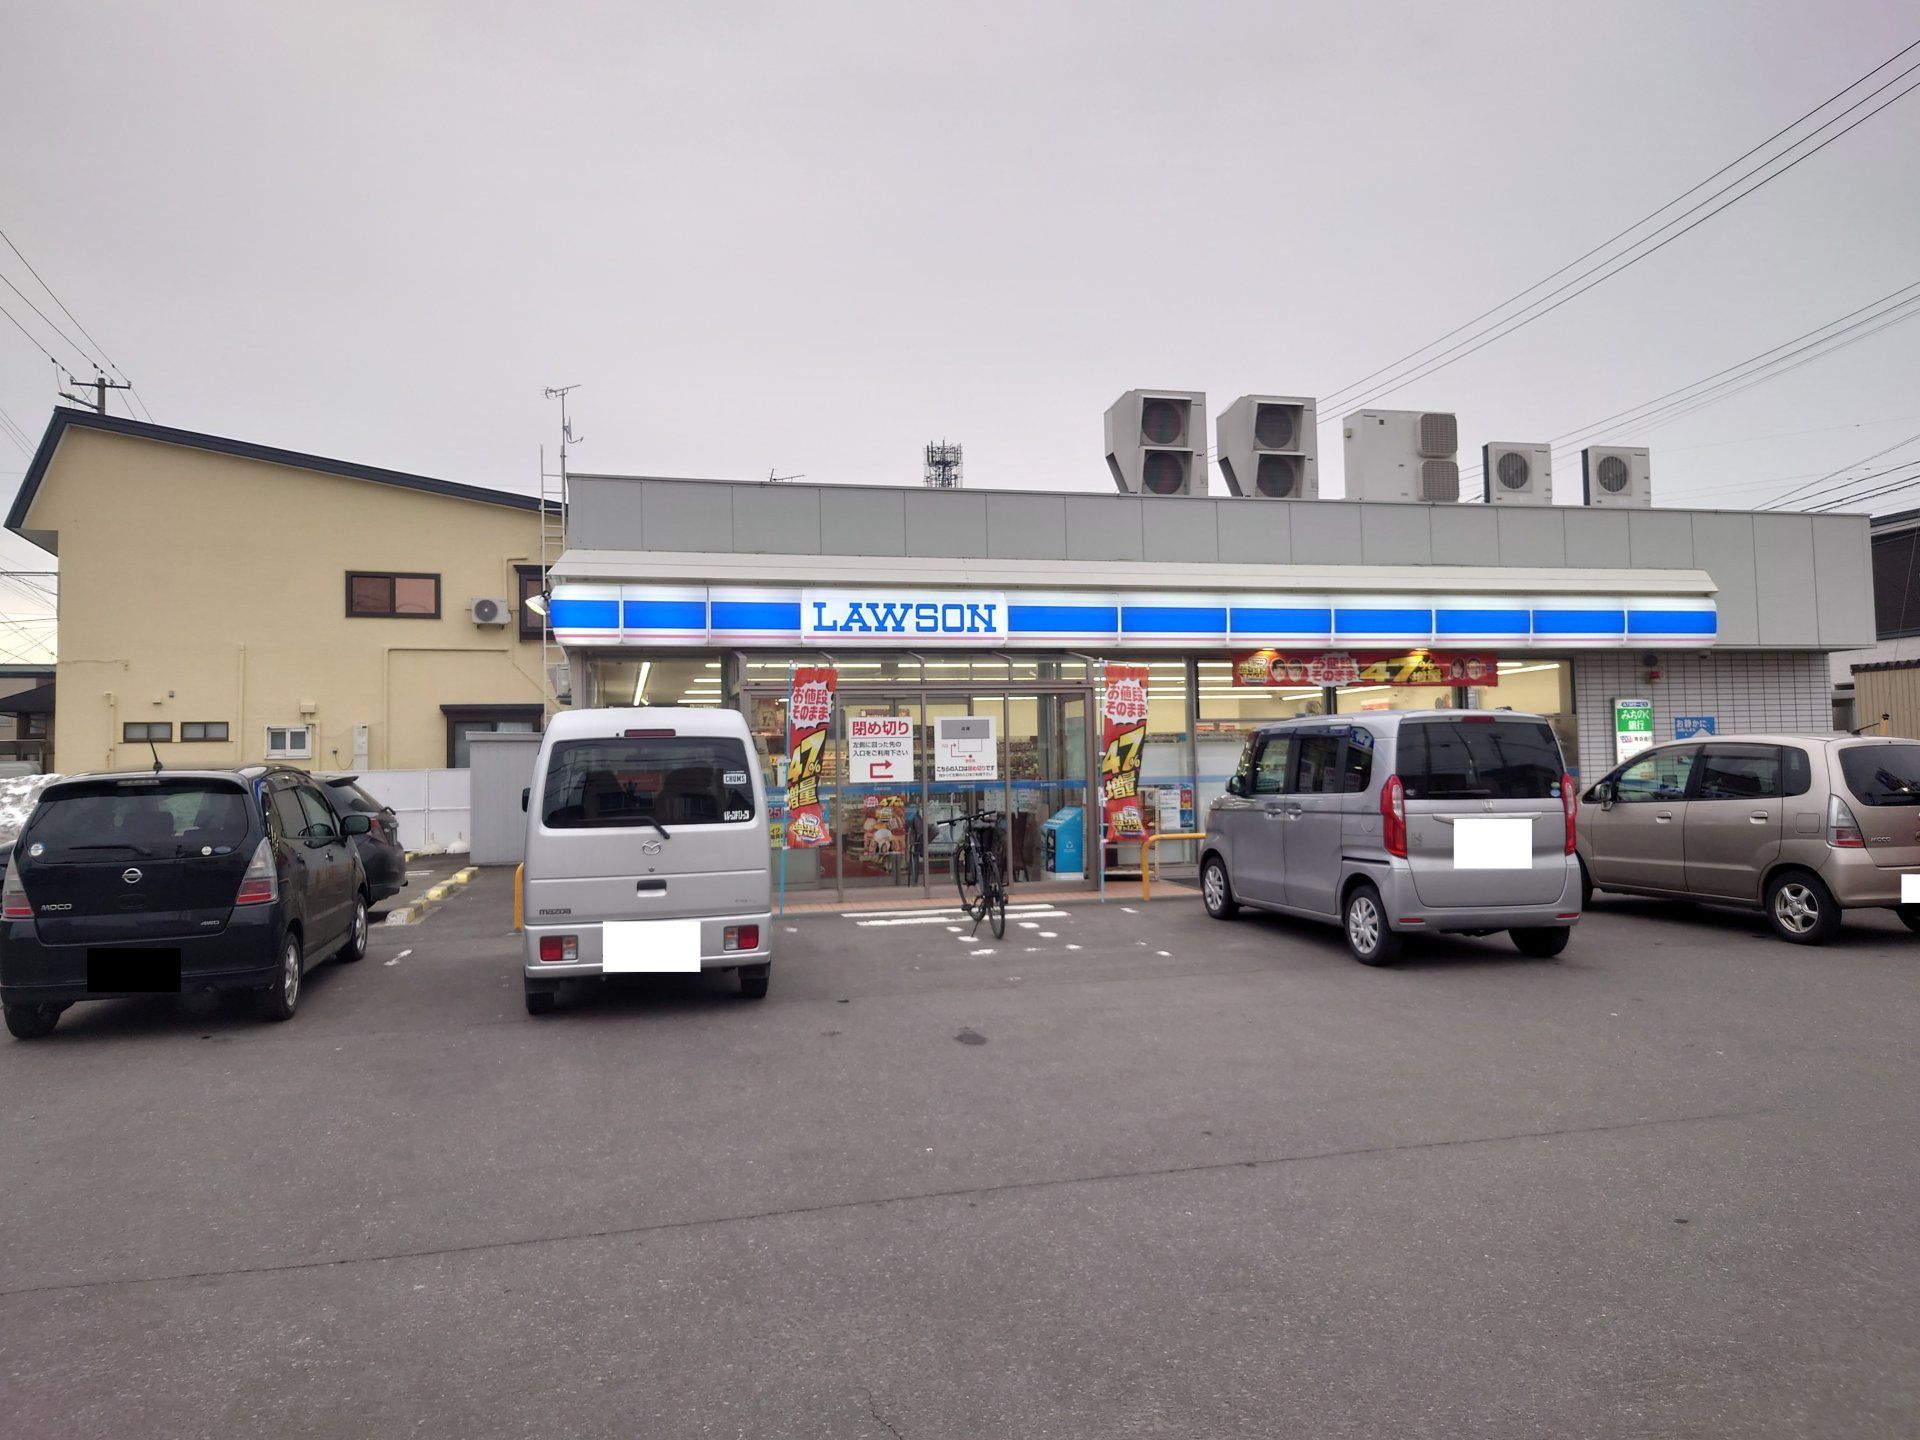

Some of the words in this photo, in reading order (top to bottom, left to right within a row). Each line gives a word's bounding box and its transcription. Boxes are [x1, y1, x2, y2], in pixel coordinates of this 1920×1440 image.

[813, 602, 996, 632] LAWSON
[1311, 669, 1359, 682] そのまま
[792, 686, 828, 705] お値段
[1107, 684, 1145, 702] お値段
[792, 705, 830, 722] そのまま
[1105, 701, 1147, 717] そのまま
[1621, 709, 1650, 720] みちのく
[852, 721, 910, 736] 閉め切り
[1628, 720, 1645, 731] 銀行
[725, 775, 746, 783] CHUMS
[1105, 771, 1136, 800] 増量
[788, 777, 819, 809] 増量
[41, 903, 72, 911] MOCO
